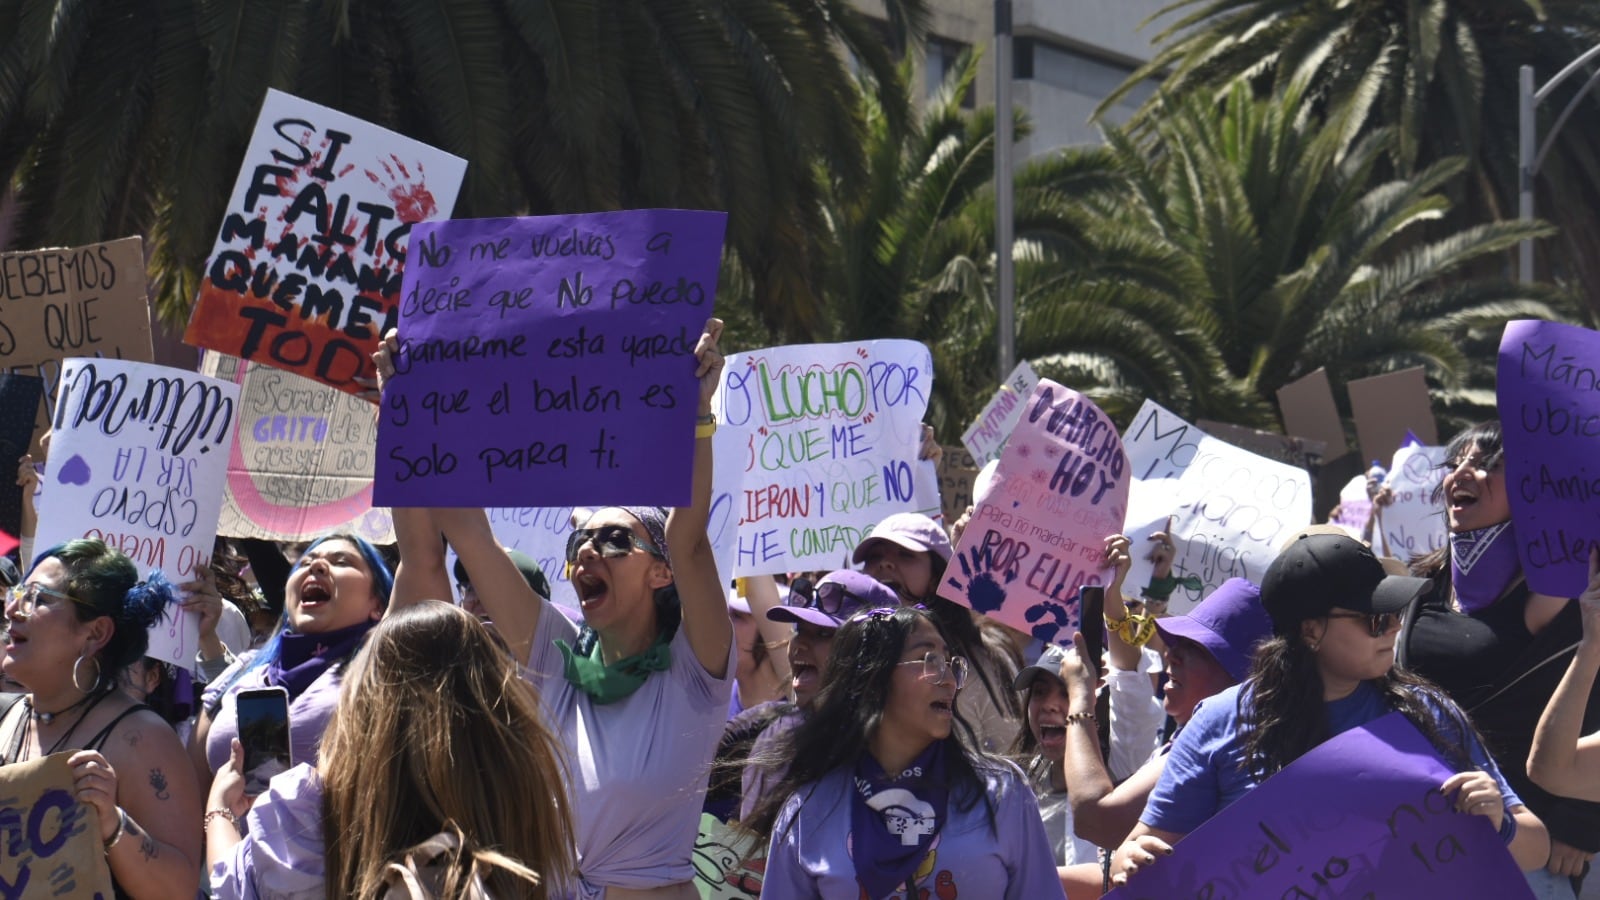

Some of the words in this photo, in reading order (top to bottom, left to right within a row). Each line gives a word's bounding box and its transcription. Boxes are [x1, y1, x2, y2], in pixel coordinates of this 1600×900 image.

[269, 118, 352, 181] SI
[418, 231, 452, 268] No
[470, 238, 511, 261] me
[531, 228, 615, 261] vuelvas
[646, 231, 673, 254] a
[488, 287, 534, 319] que
[557, 271, 594, 309] No
[44, 298, 102, 351] QUE
[240, 306, 364, 385] TOD
[547, 326, 605, 358] esta
[253, 375, 336, 414] Somos
[390, 394, 409, 427] y
[421, 389, 471, 425] que
[487, 382, 511, 416] el
[533, 375, 621, 413] balón
[640, 384, 676, 409] es
[758, 362, 865, 422] LUCHO
[867, 361, 926, 412] POR
[1013, 374, 1028, 394] DE
[253, 415, 328, 443] GRITO
[331, 413, 360, 445] de
[760, 426, 830, 471] QUE
[831, 423, 873, 460] ME
[1028, 386, 1124, 480] MARCHO
[113, 447, 147, 483] LA
[157, 455, 198, 497] SER
[336, 449, 369, 471] no
[389, 443, 457, 482] Solo
[590, 428, 620, 469] ti.
[1049, 451, 1115, 505] HOY
[91, 486, 198, 537] espero
[739, 483, 810, 525] IERON
[831, 474, 882, 514] QUE
[882, 460, 914, 503] NO
[737, 529, 786, 568] HE
[977, 503, 1013, 528] para
[1030, 524, 1078, 553] marchar
[979, 529, 1030, 578] POR
[1411, 833, 1466, 873] la
